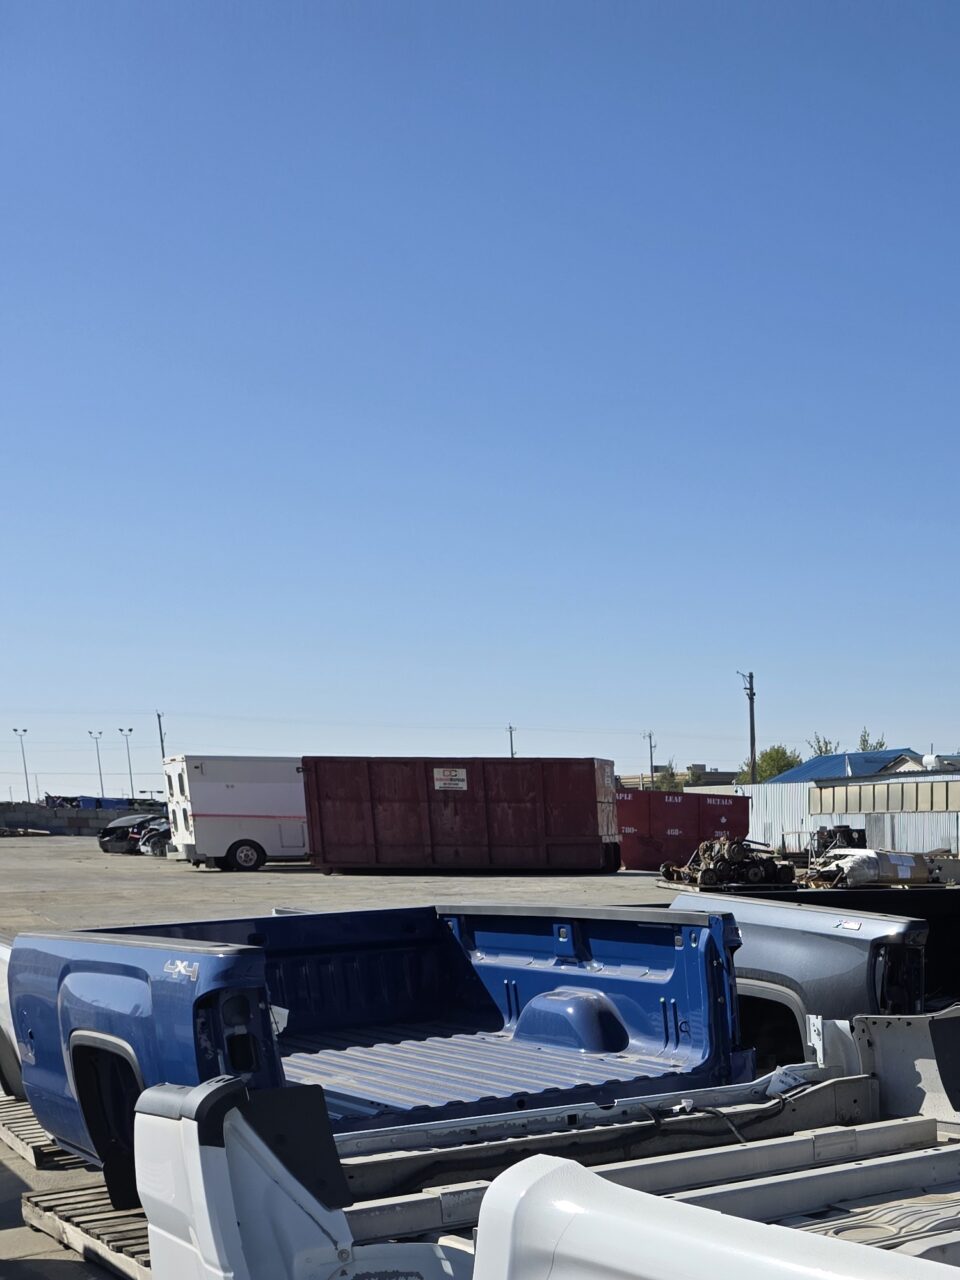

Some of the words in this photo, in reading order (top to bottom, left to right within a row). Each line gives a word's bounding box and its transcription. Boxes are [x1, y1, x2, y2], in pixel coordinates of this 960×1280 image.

[615, 793, 633, 801] APLE
[665, 795, 683, 803] LEAF
[707, 797, 733, 805] METALS
